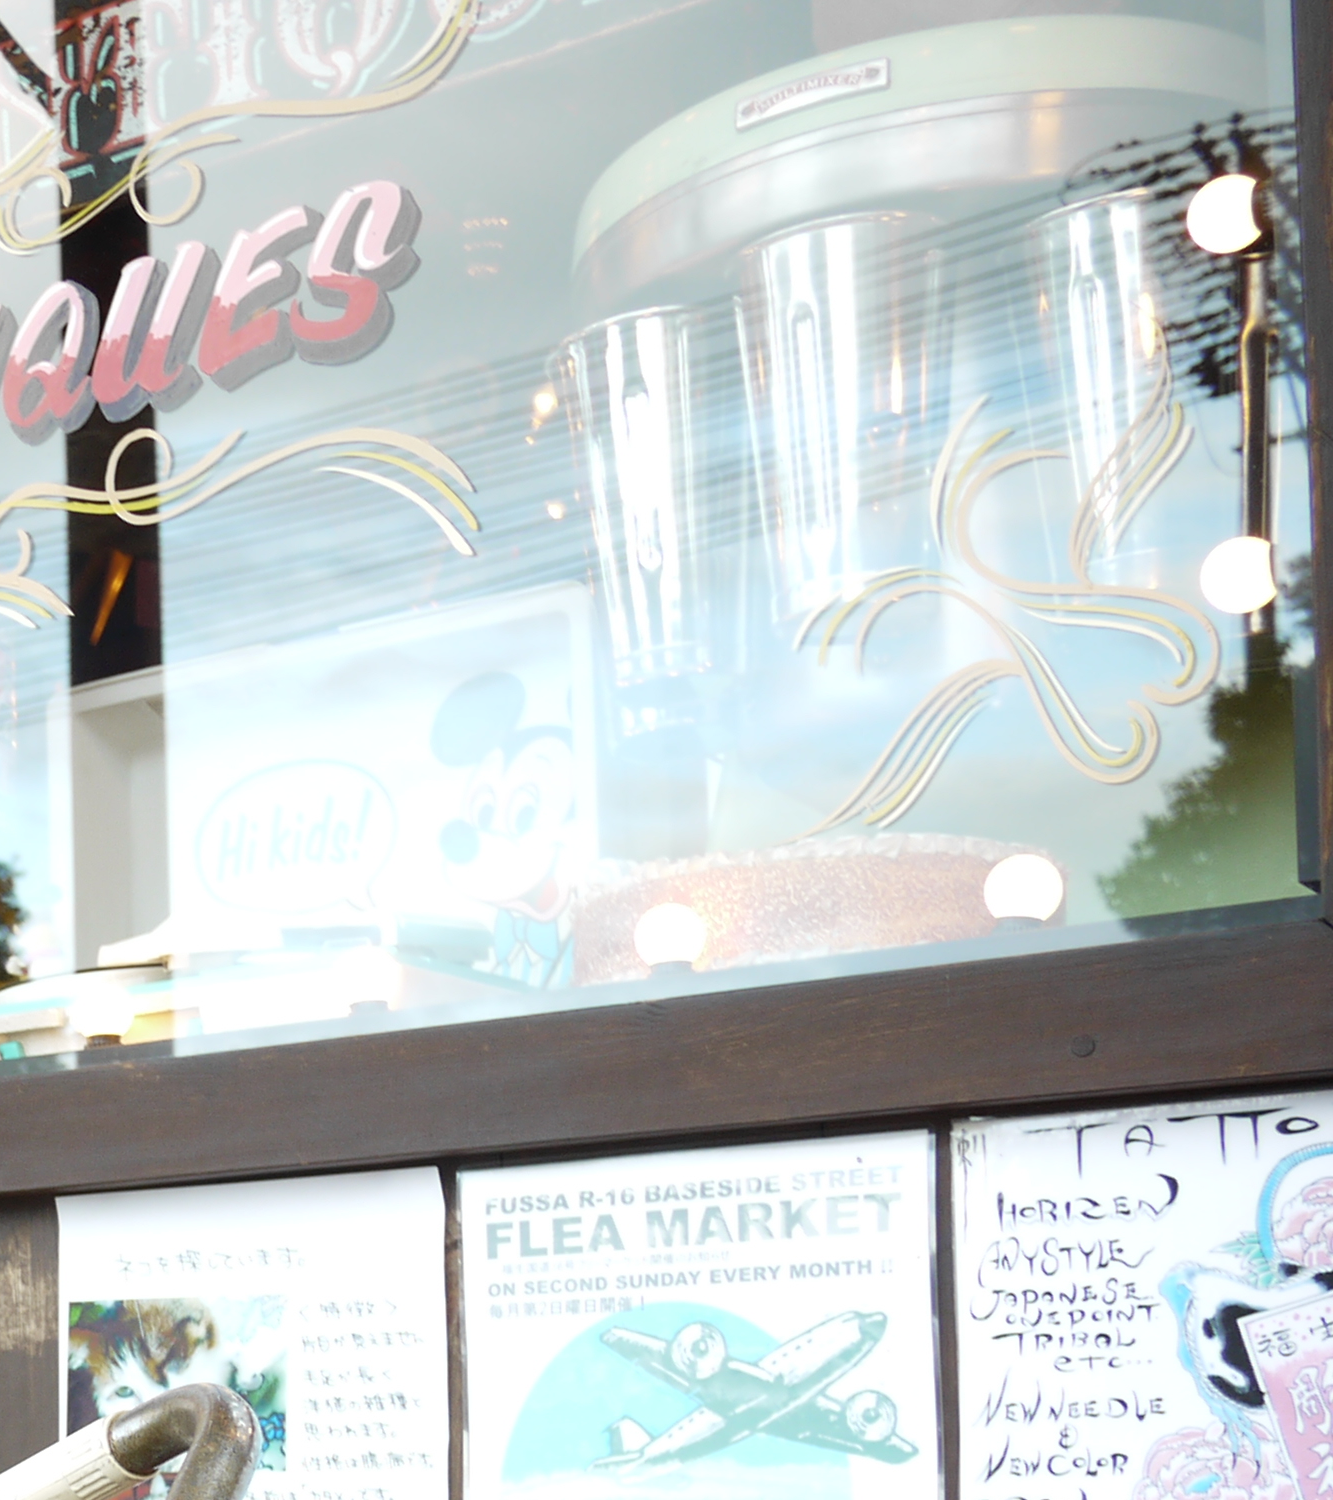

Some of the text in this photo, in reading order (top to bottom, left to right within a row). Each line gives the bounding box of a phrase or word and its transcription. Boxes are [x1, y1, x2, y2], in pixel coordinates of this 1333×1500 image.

[757, 69, 864, 115] MULTIMIXER
[215, 785, 375, 884] Hi kids!
[485, 1164, 904, 1216] FUSSA R-16 BASESIDE STREET
[485, 1192, 903, 1260] FLEA MARKET
[488, 1279, 517, 1298] ON
[523, 1274, 608, 1295] SECOND
[615, 1270, 702, 1290] SUNDAY
[709, 1265, 781, 1285] EVERY
[789, 1258, 873, 1280] MONTH
[1048, 1391, 1167, 1421] NEEDLE
[1047, 1452, 1129, 1478] COLOR
